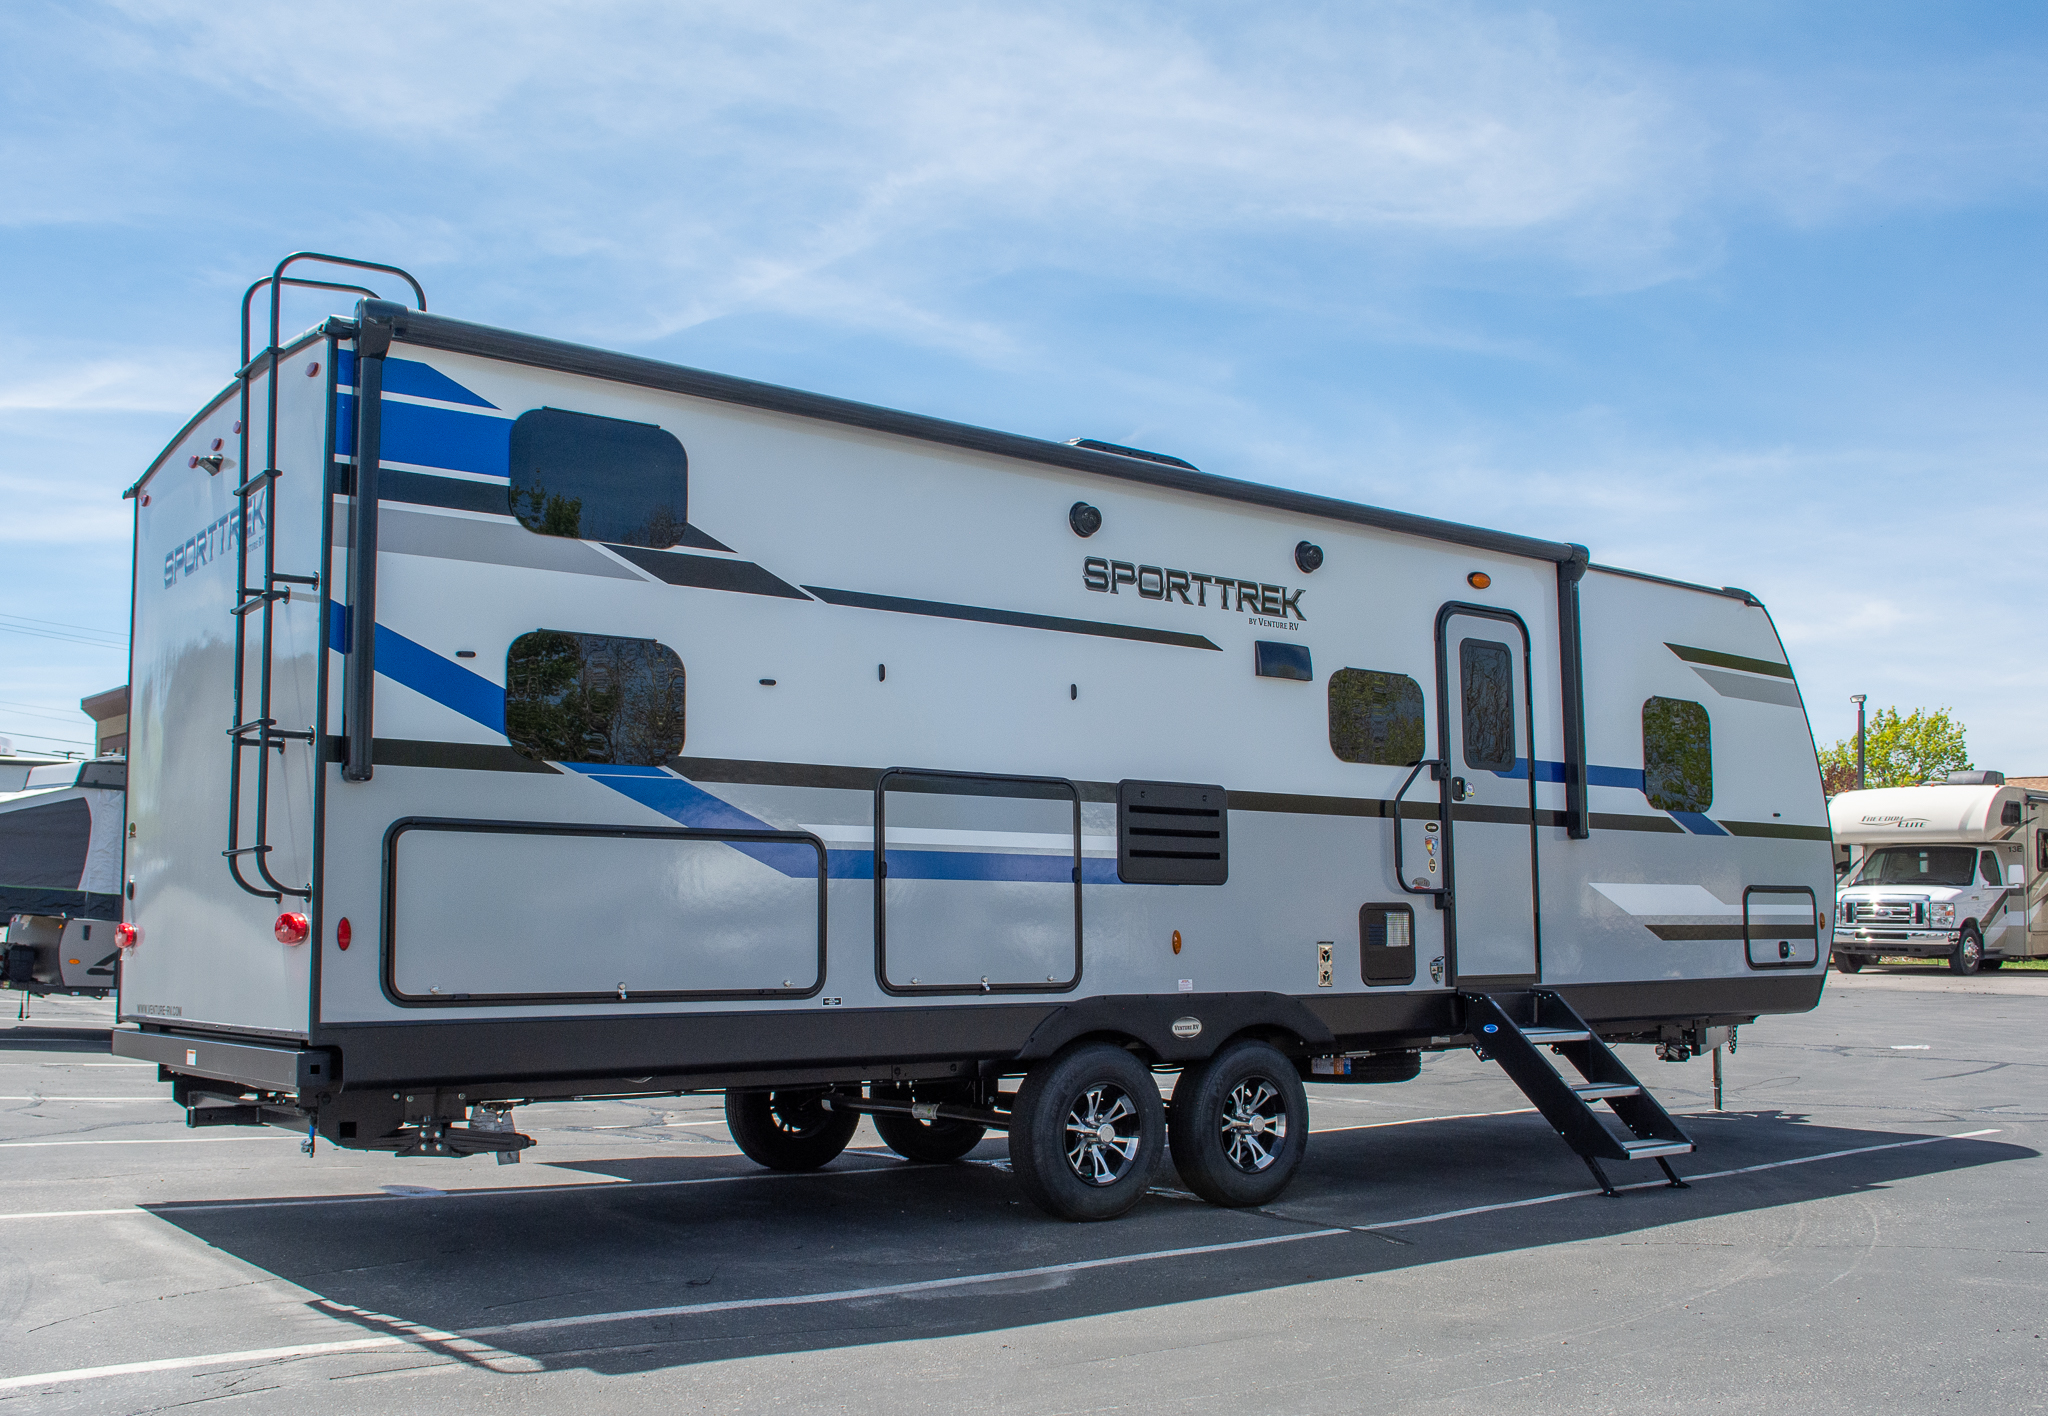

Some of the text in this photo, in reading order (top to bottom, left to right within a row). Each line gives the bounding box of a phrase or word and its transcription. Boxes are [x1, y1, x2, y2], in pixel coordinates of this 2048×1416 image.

[1083, 556, 1307, 621] SPORTTREK
[1248, 617, 1299, 631] BY VENTURE RV
[1897, 820, 1927, 828] ELITE
[2008, 845, 2023, 853] 13E
